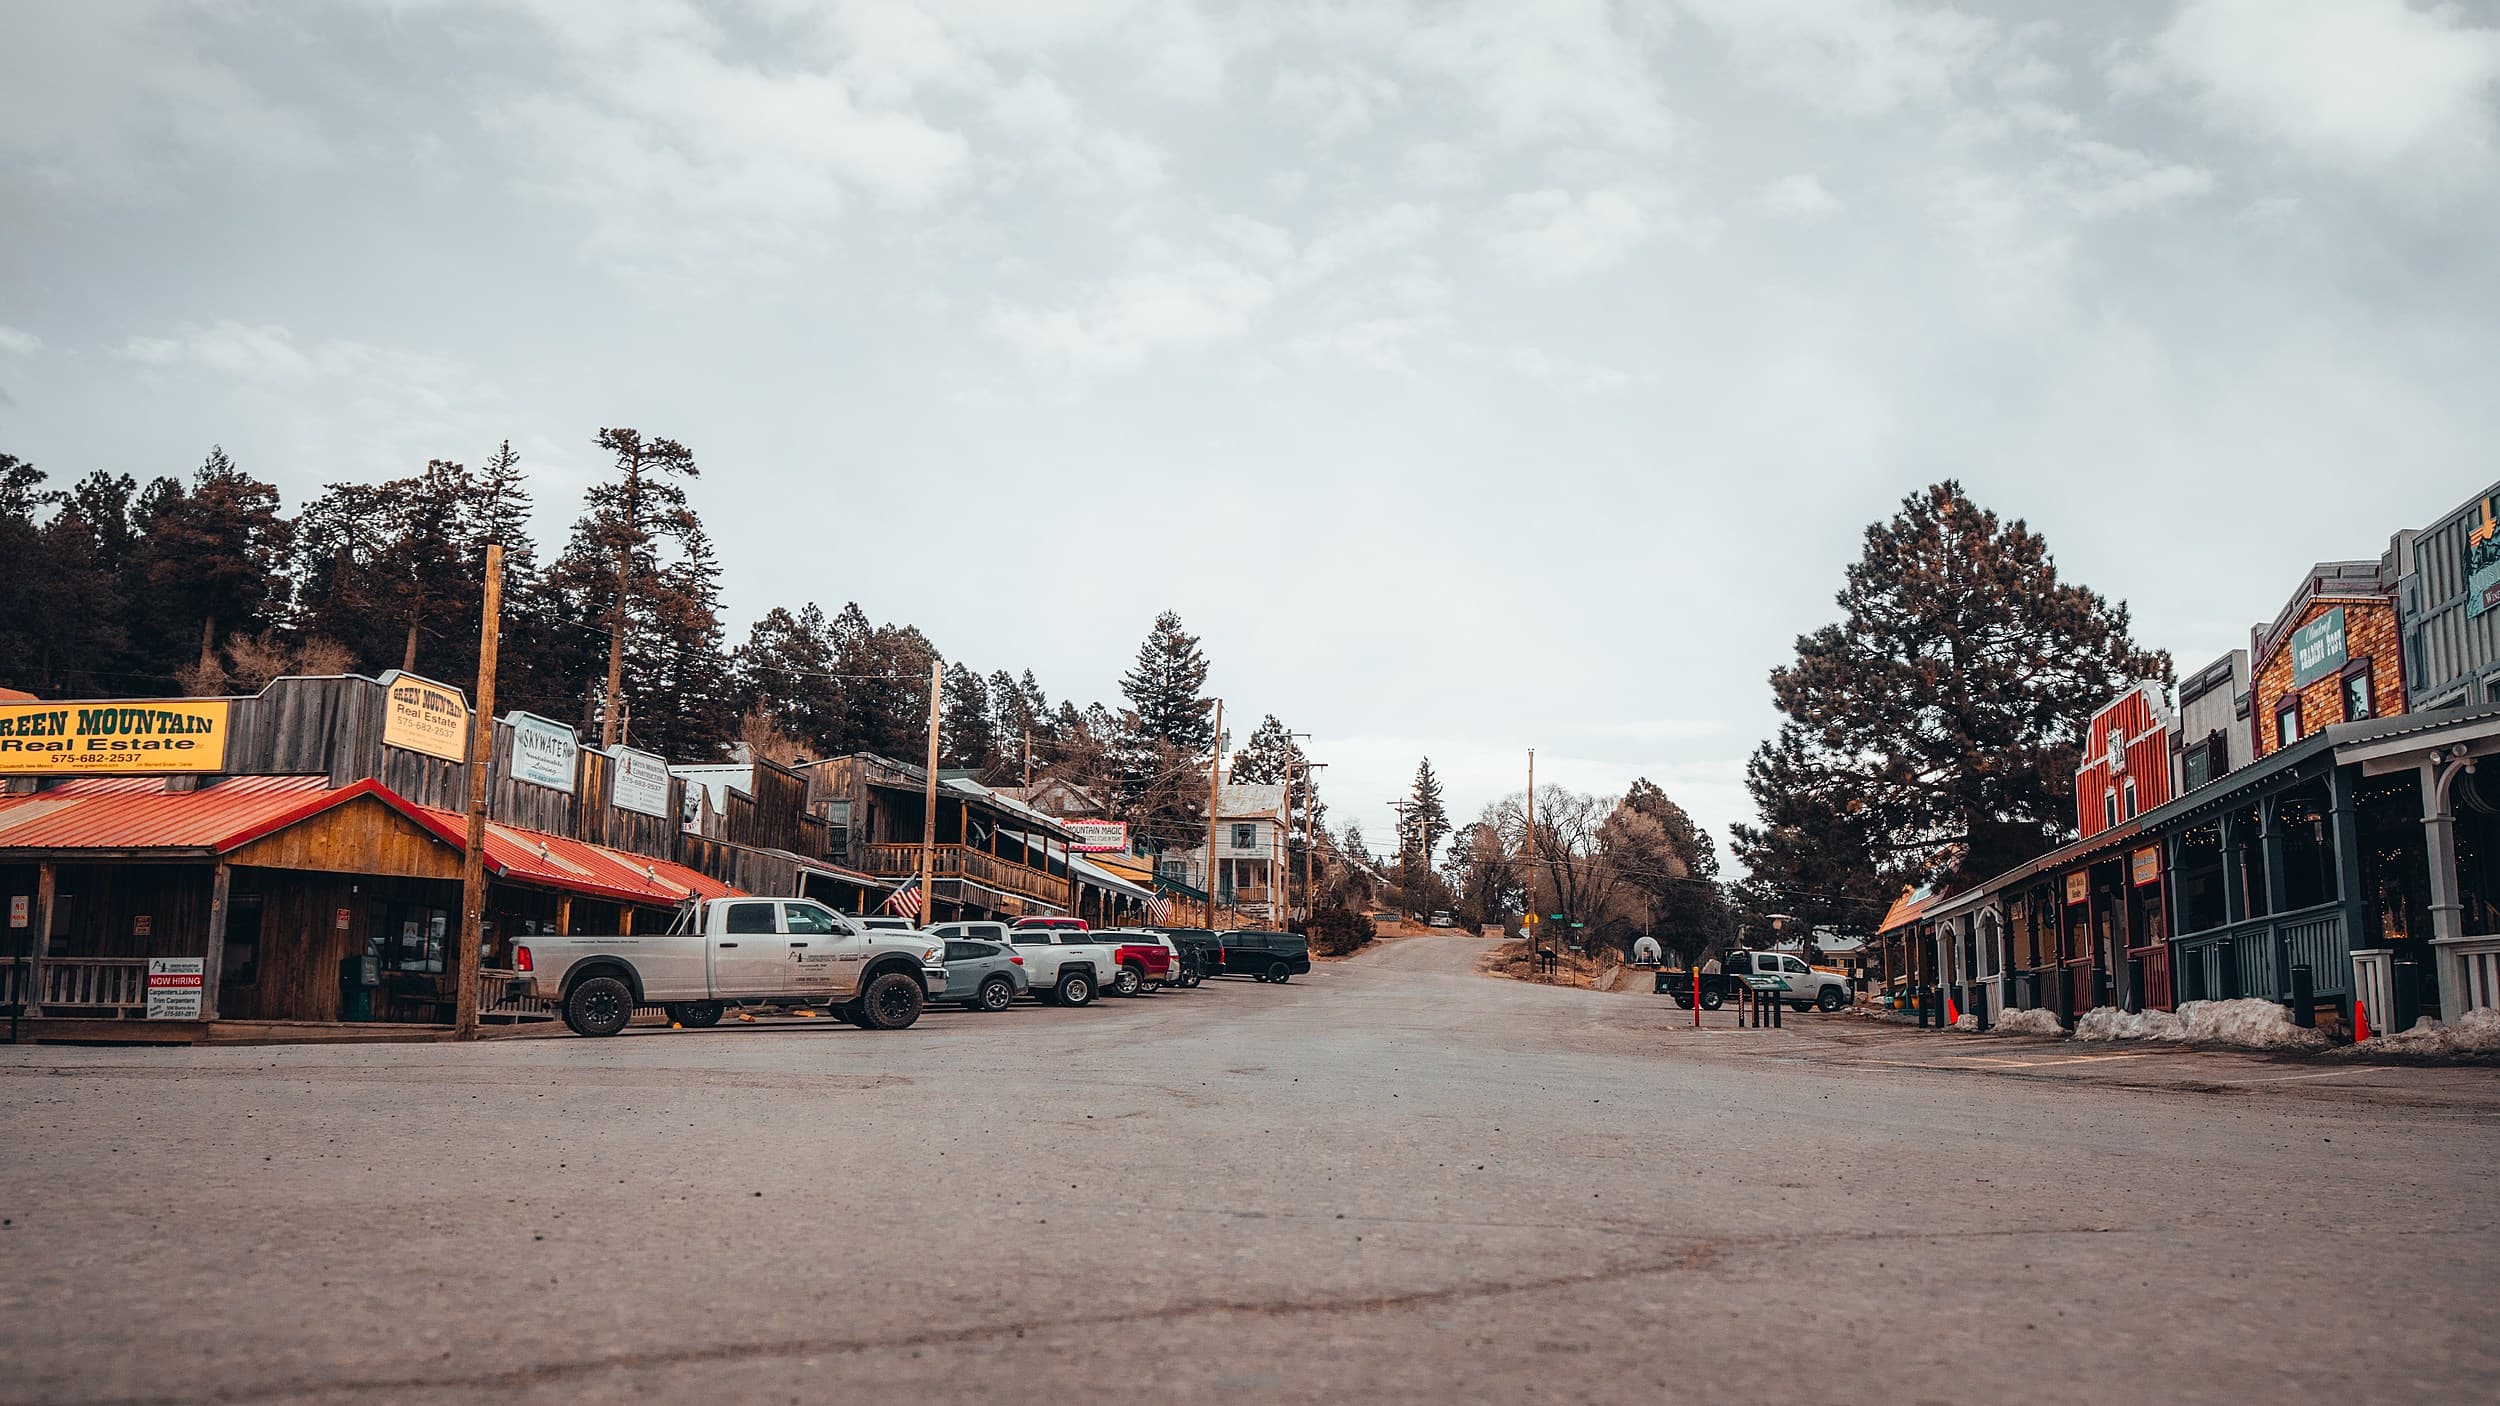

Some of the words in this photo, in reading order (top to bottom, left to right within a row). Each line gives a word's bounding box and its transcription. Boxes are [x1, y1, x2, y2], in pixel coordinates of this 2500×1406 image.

[2300, 639, 2325, 672] TRADING
[2326, 628, 2342, 657] POST
[394, 687, 421, 706] GREEN
[422, 689, 463, 719] MOUNTAIN
[77, 707, 213, 735] MOUNTAIN
[396, 716, 455, 739] 575-682-2537
[397, 703, 421, 718] Real
[424, 711, 457, 729] Estate
[1, 738, 74, 752] Real
[87, 738, 195, 751] Estate
[523, 728, 569, 760] SKYWATER
[51, 753, 142, 763] 575-682-2537
[526, 751, 563, 768] Sustainable
[1065, 825, 1100, 835] MOUNTAIN
[1101, 826, 1123, 835] MAGIC
[150, 976, 171, 985] NOW
[172, 976, 201, 985] HIRING
